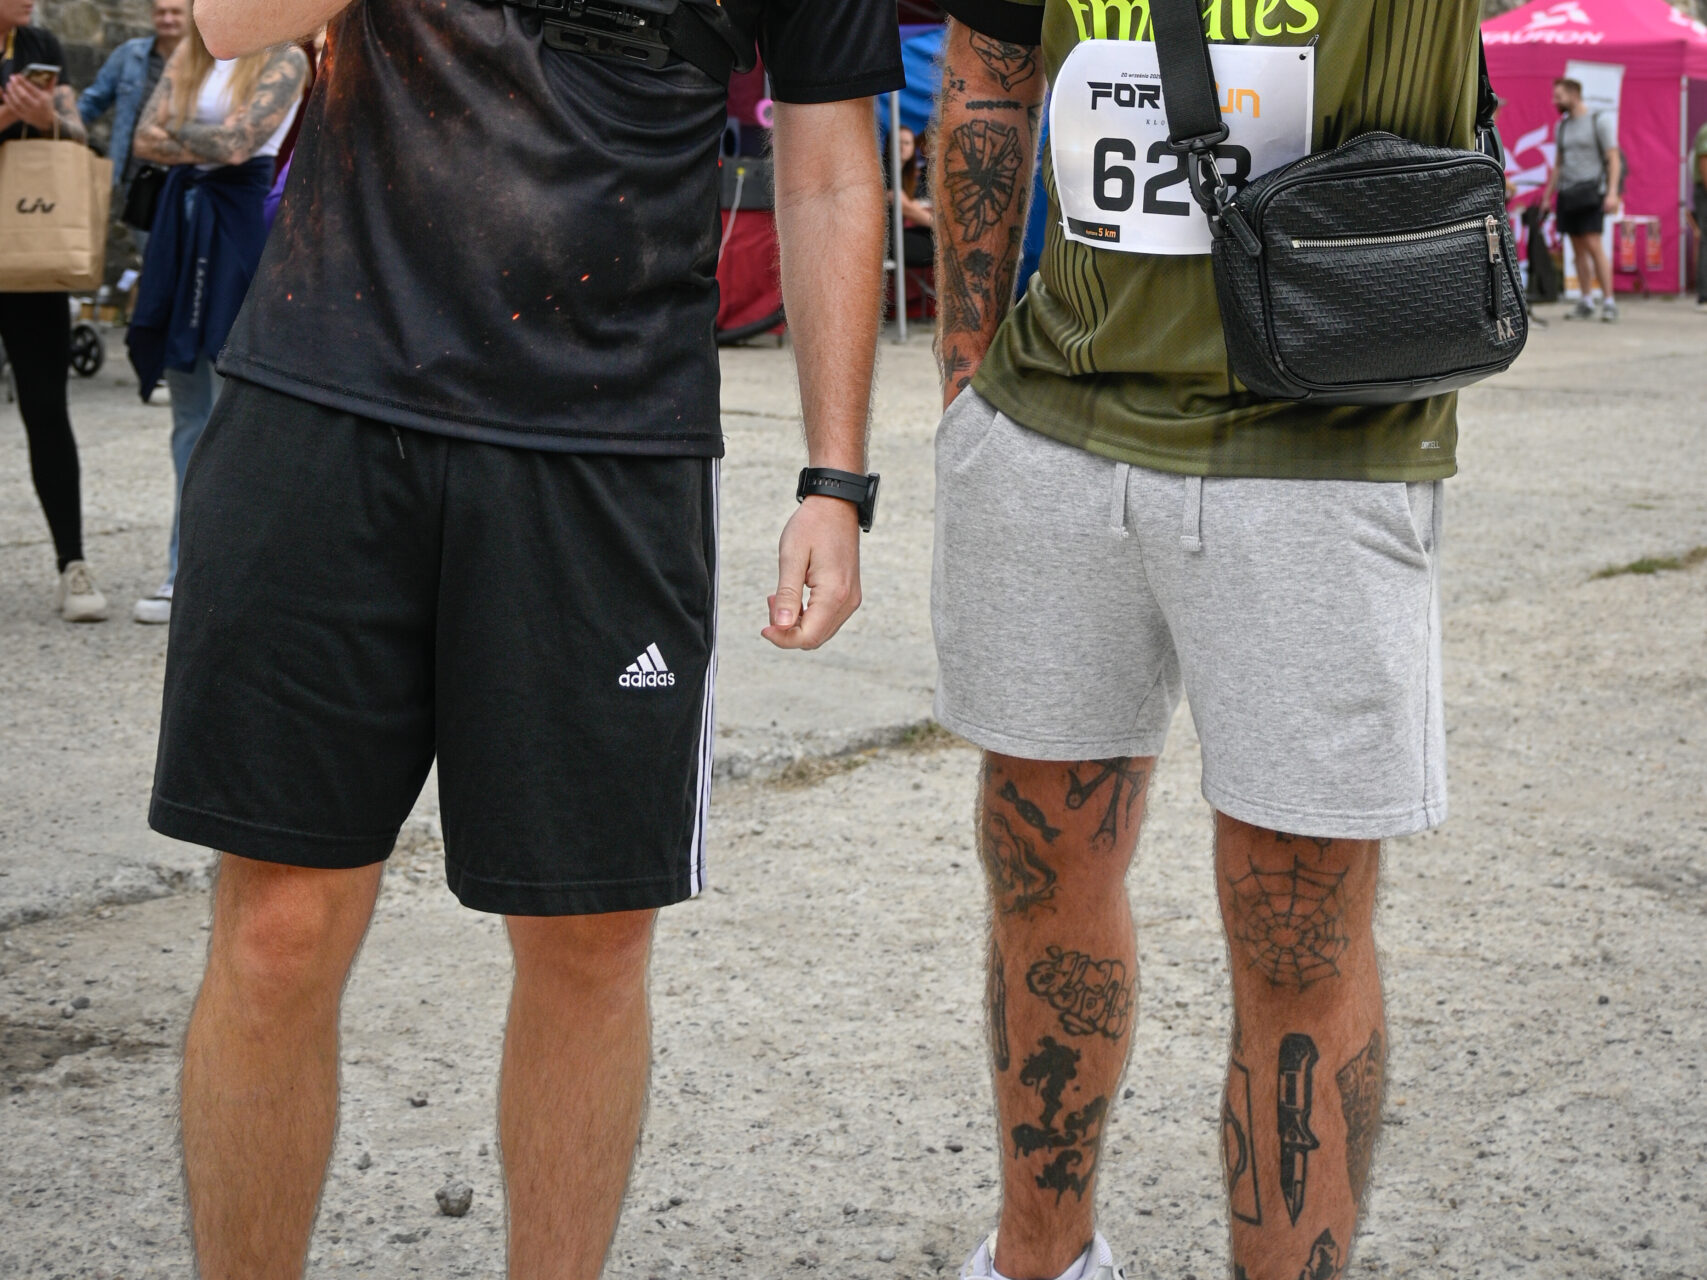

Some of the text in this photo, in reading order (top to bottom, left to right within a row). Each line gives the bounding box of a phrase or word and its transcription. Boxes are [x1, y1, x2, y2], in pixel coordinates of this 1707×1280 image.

[1087, 81, 1161, 110] FOR
[1093, 137, 1251, 217] 628
[16, 197, 55, 214] Liv
[1098, 226, 1104, 237] 5
[1104, 227, 1117, 239] km
[618, 670, 676, 688] adidas
